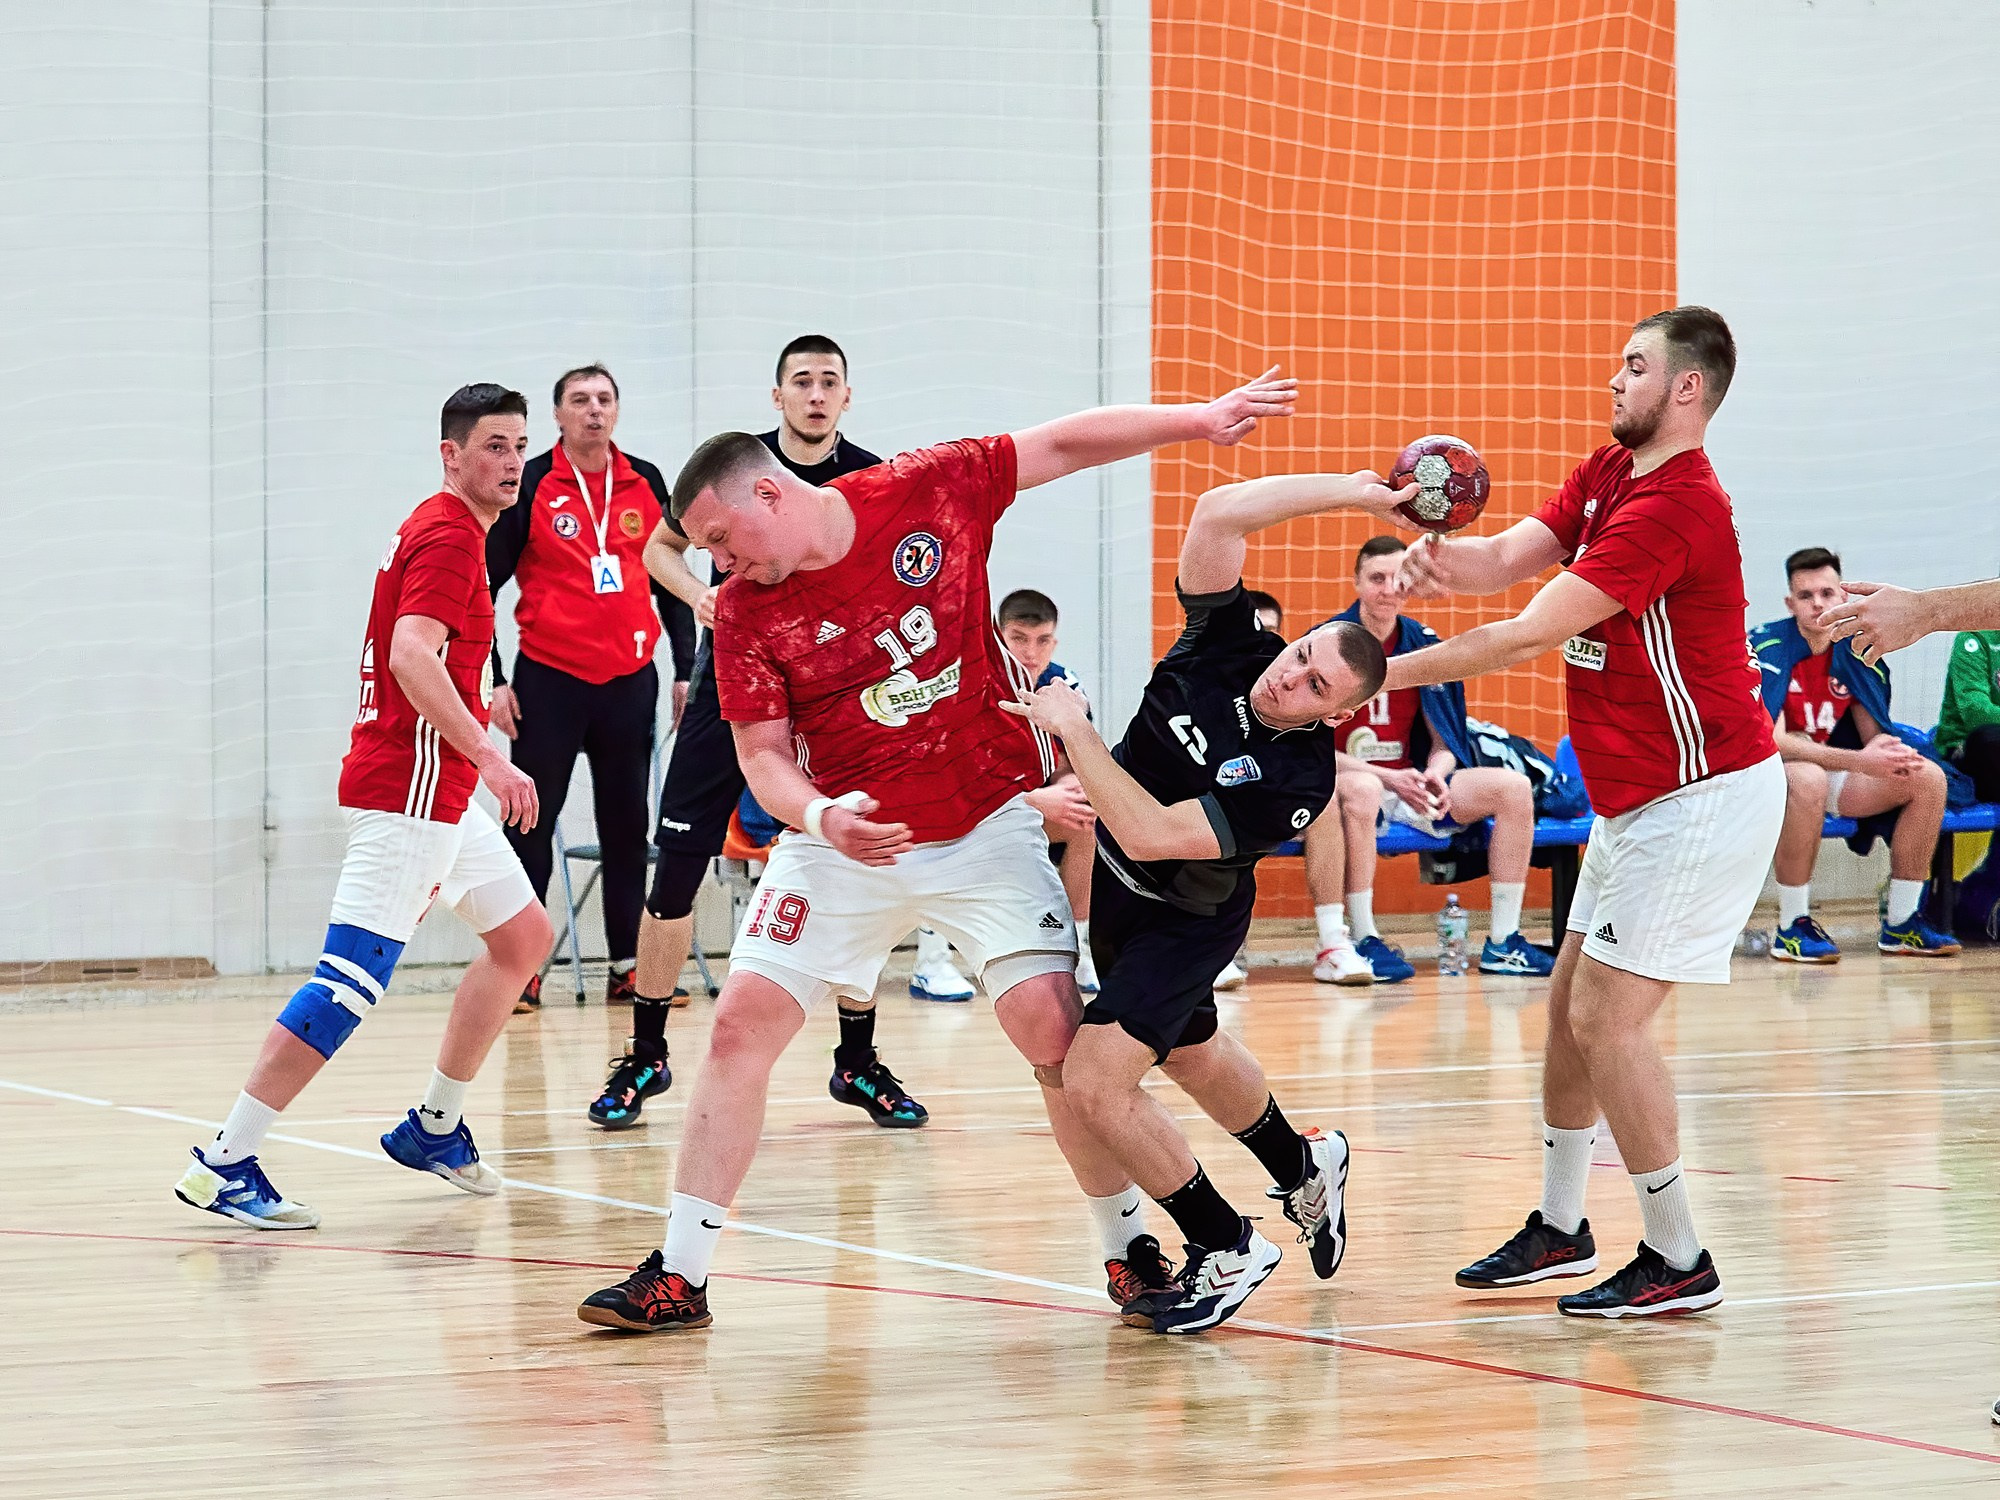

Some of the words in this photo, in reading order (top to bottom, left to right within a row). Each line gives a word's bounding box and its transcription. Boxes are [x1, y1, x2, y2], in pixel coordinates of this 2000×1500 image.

[873, 604, 938, 673] 19
[1803, 701, 1837, 735] 14
[746, 887, 811, 946] 19
